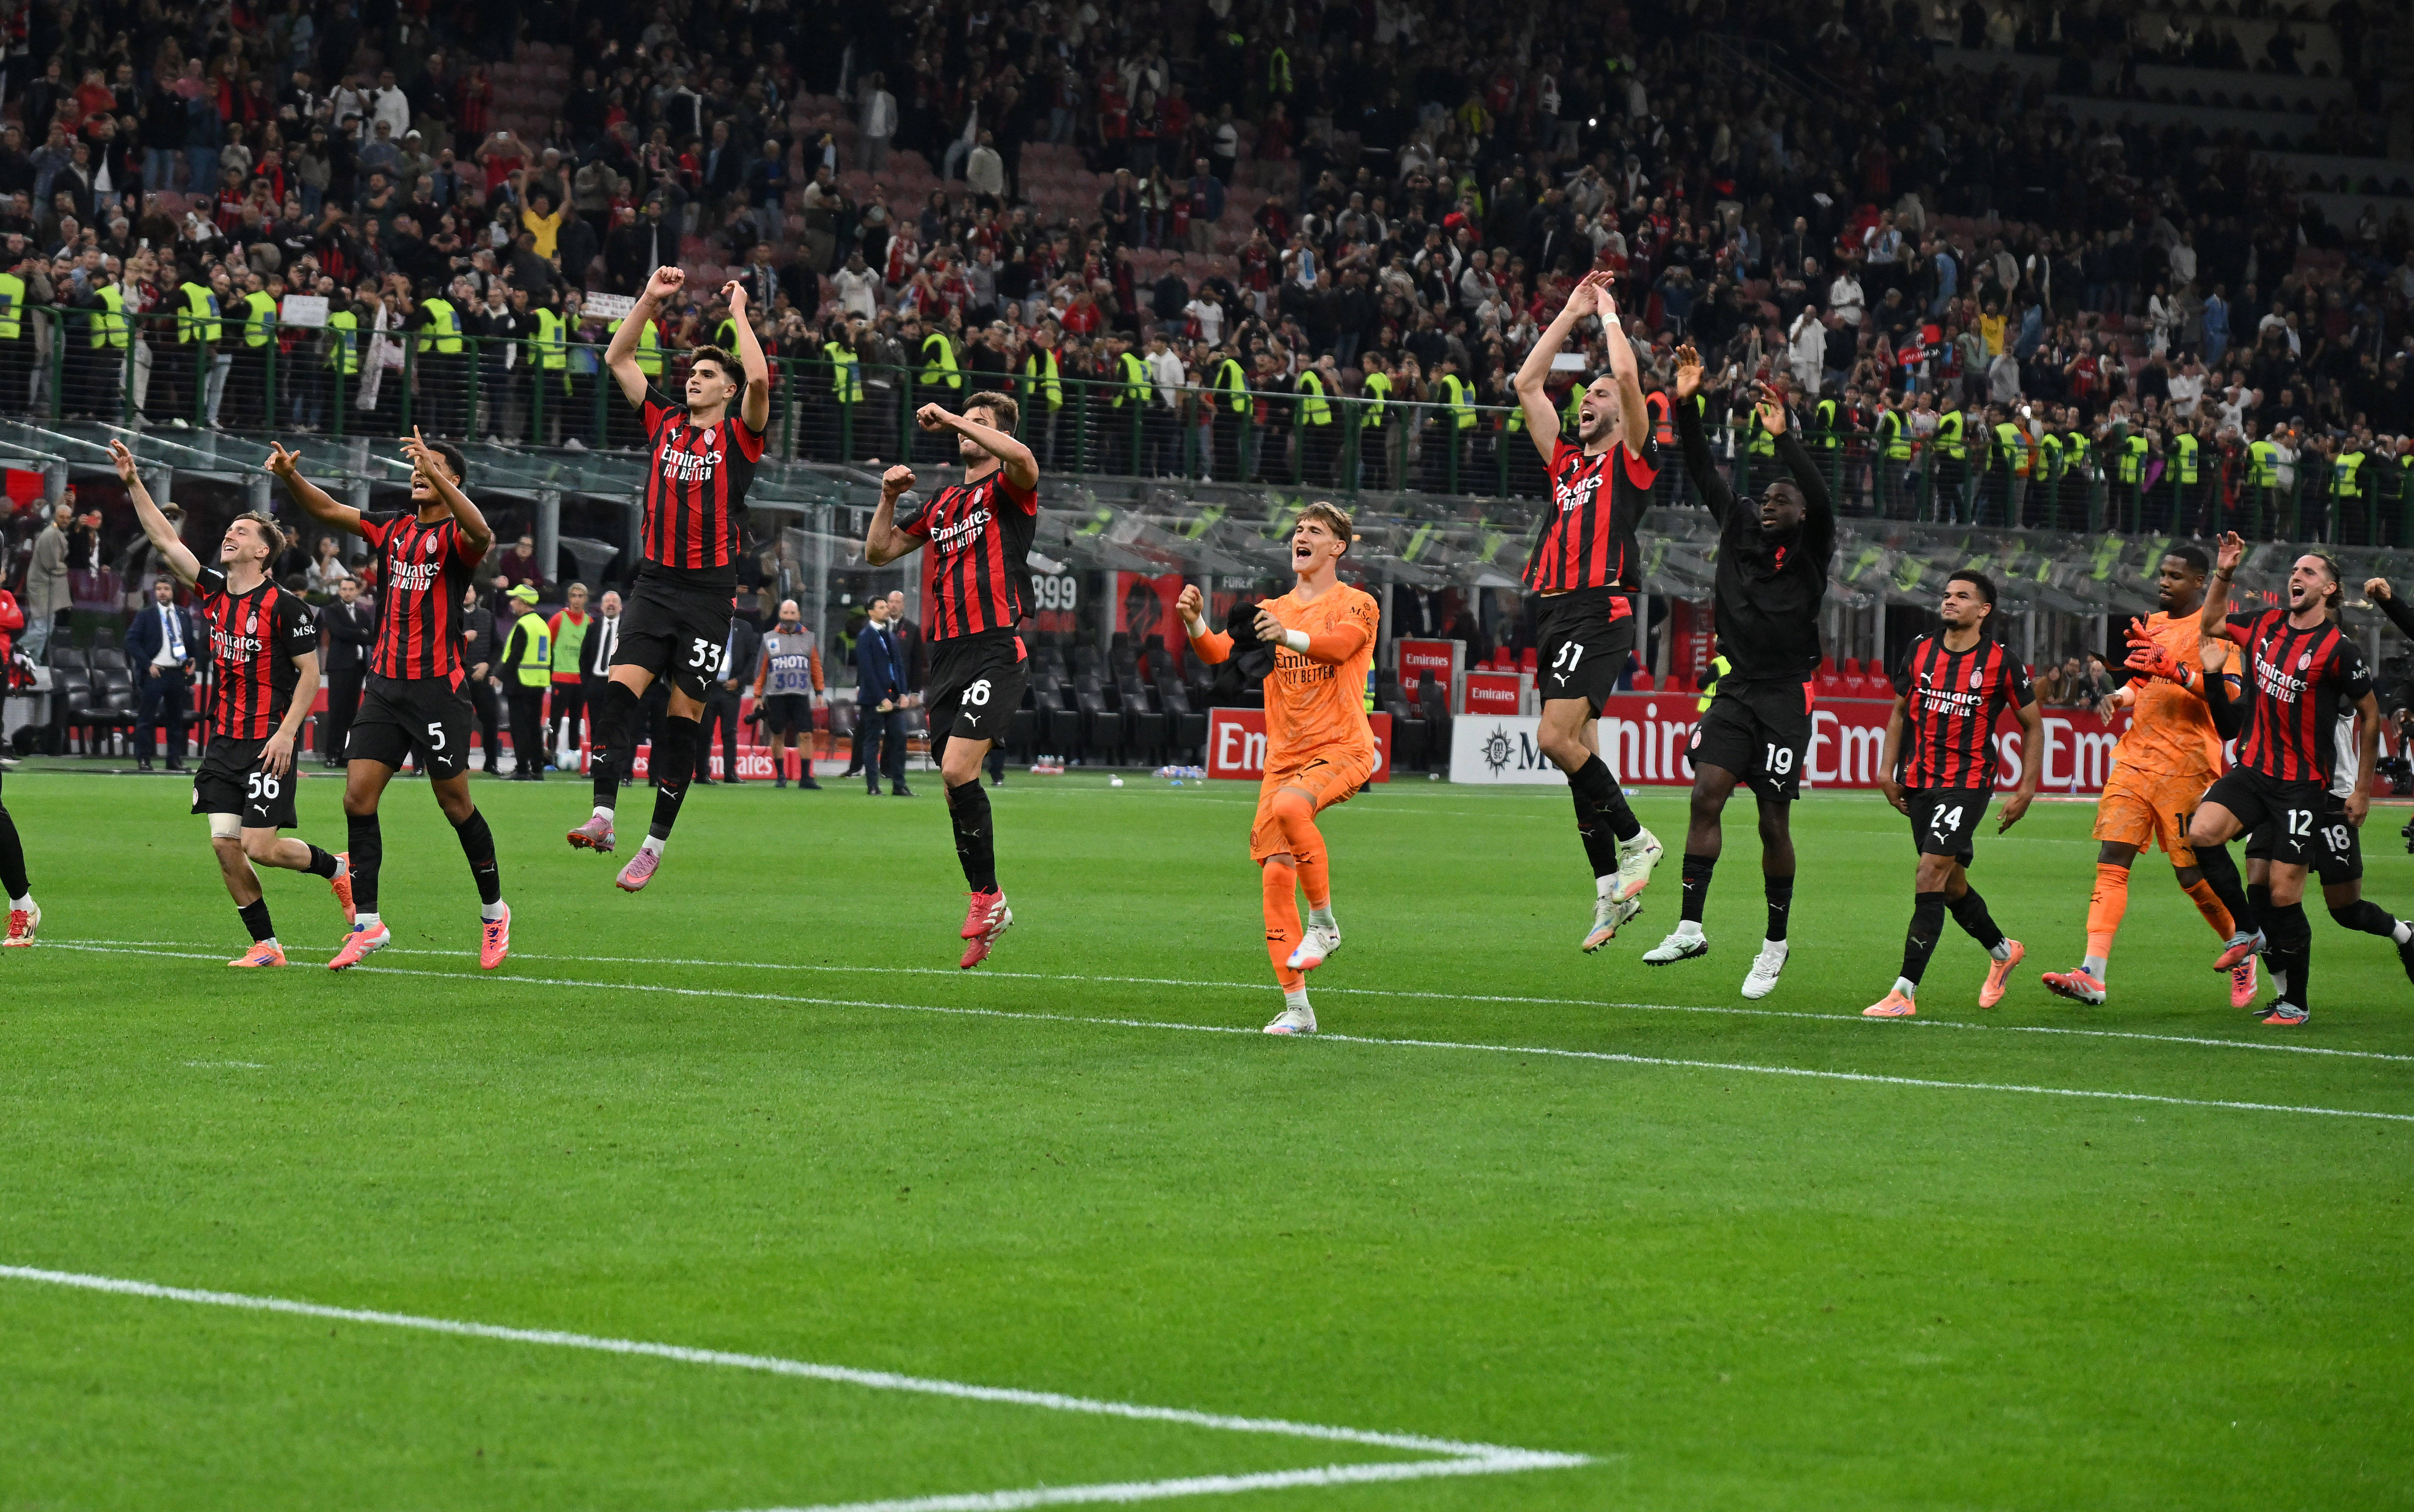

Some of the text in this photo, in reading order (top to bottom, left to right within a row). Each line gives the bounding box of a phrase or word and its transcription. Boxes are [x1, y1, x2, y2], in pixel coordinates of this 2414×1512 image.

[661, 444, 722, 468] Emiraes
[663, 464, 712, 481] FLY BETTER
[1556, 474, 1603, 497] mates
[930, 508, 992, 542] Emirates
[941, 537, 954, 553] FLY
[389, 554, 440, 577] Emirates
[400, 577, 431, 591] BETTER
[293, 624, 316, 637] MSC
[223, 646, 251, 662] BETTER
[689, 638, 722, 672] 33
[1406, 653, 1449, 666] Emirates
[775, 672, 808, 689] 303
[1301, 664, 1335, 684] BETTER
[2255, 652, 2309, 692] Emirates
[1472, 687, 1515, 701] Emirates
[2265, 682, 2296, 703] BETTER
[1924, 697, 1971, 717] FLY BETTER
[428, 722, 446, 750] 5
[1765, 743, 1793, 775] 19
[248, 772, 279, 799] 56
[1930, 804, 1963, 831] 24
[2287, 809, 2313, 836] 12
[2321, 824, 2350, 852] 18
